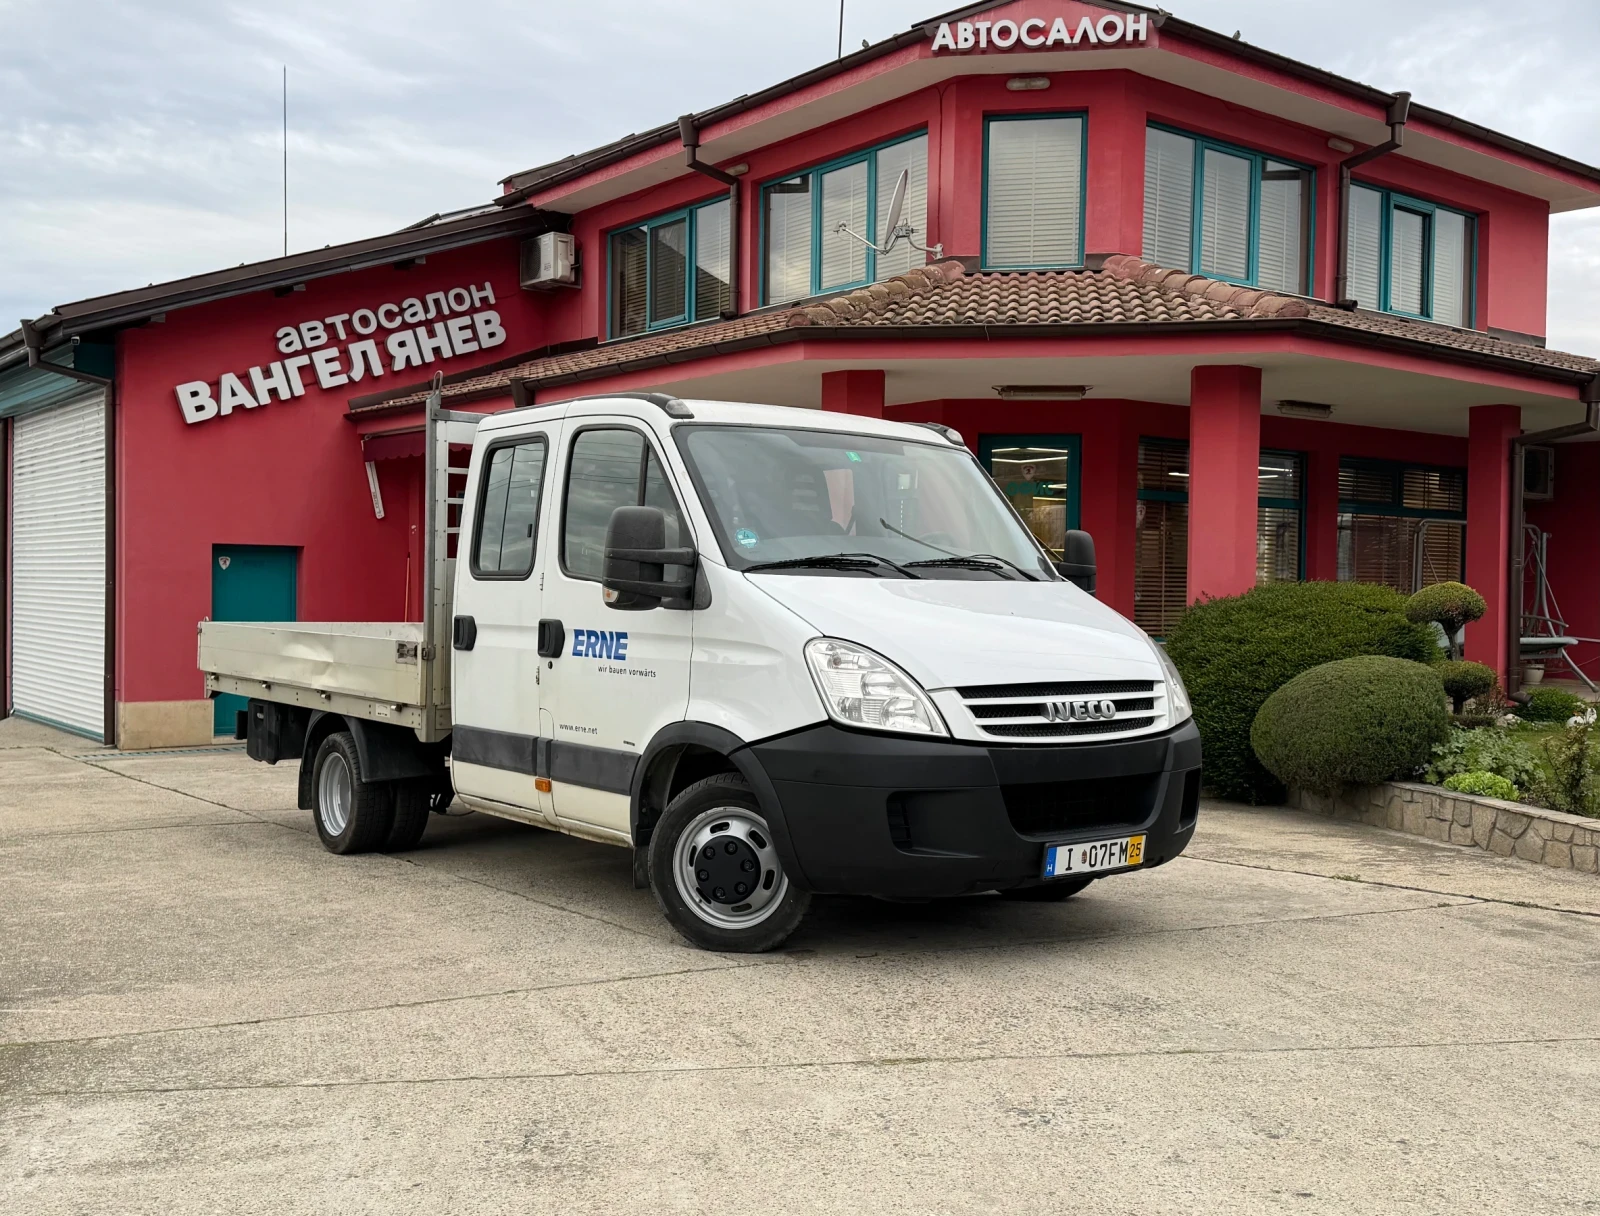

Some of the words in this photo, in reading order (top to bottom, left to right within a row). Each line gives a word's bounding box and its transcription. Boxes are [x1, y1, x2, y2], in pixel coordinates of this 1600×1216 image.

[931, 13, 1148, 50] АВТОСАЛОН
[174, 338, 384, 424] ВАНГЕЛ
[385, 310, 507, 372] ЯНЕВ
[572, 628, 628, 661] ERNE
[598, 664, 607, 673] wir
[609, 665, 627, 675] bauen
[629, 668, 657, 678] vorwärts
[1043, 700, 1116, 722] IVECO
[559, 724, 598, 735] www.erne.net
[1046, 864, 1053, 872] H
[1129, 842, 1142, 858] 25
